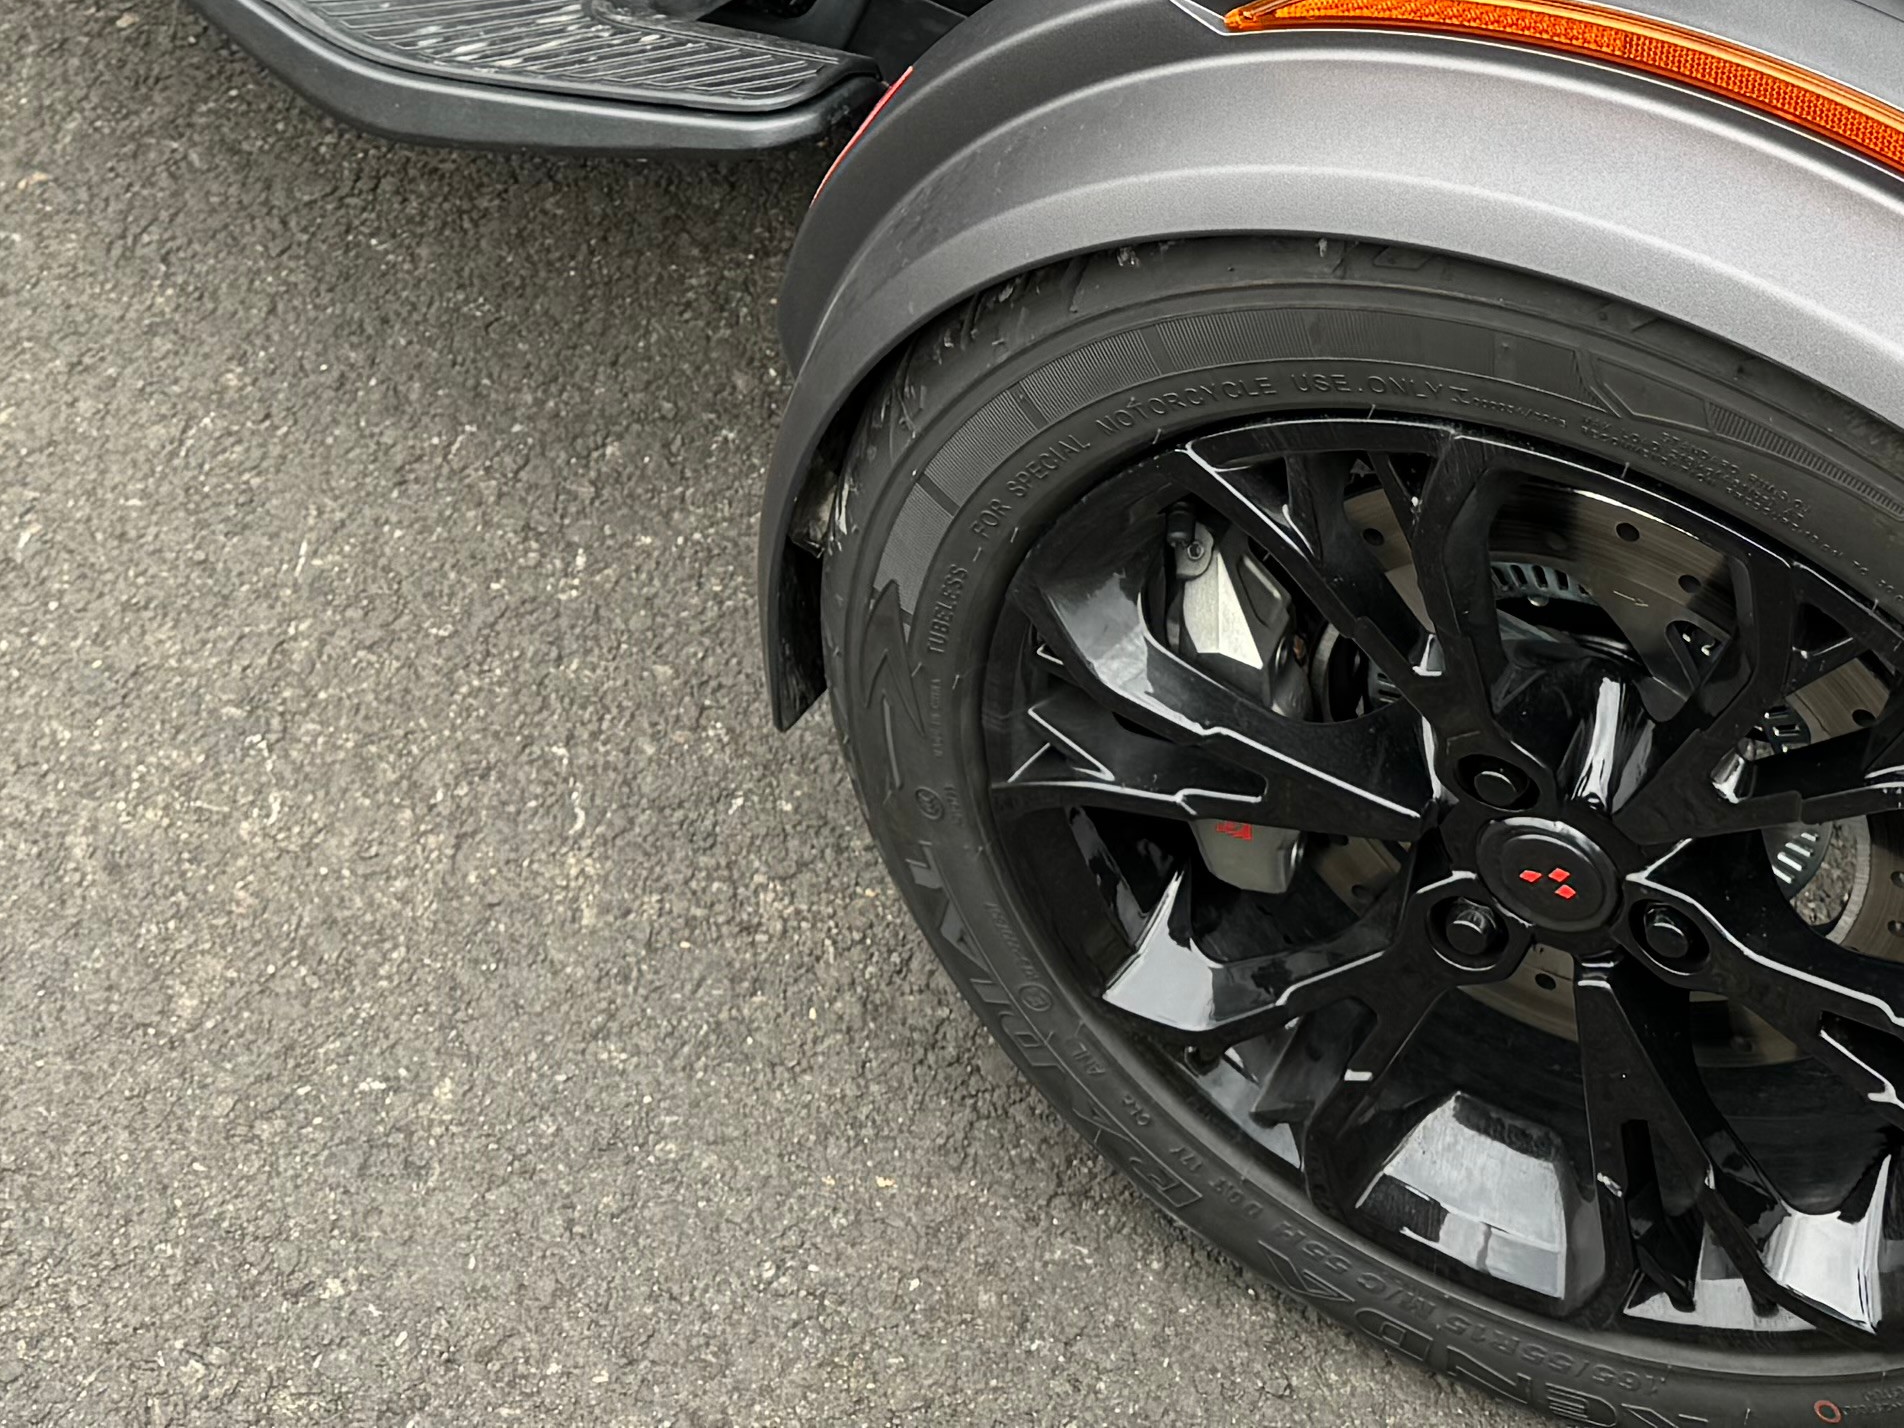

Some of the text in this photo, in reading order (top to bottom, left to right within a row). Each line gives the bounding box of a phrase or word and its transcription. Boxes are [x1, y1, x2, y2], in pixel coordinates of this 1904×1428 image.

[927, 563, 967, 656] TUBELESS
[971, 498, 1011, 538] FOR
[1005, 433, 1090, 498] SPECIAL
[1095, 376, 1278, 436] MOTORCYCLE
